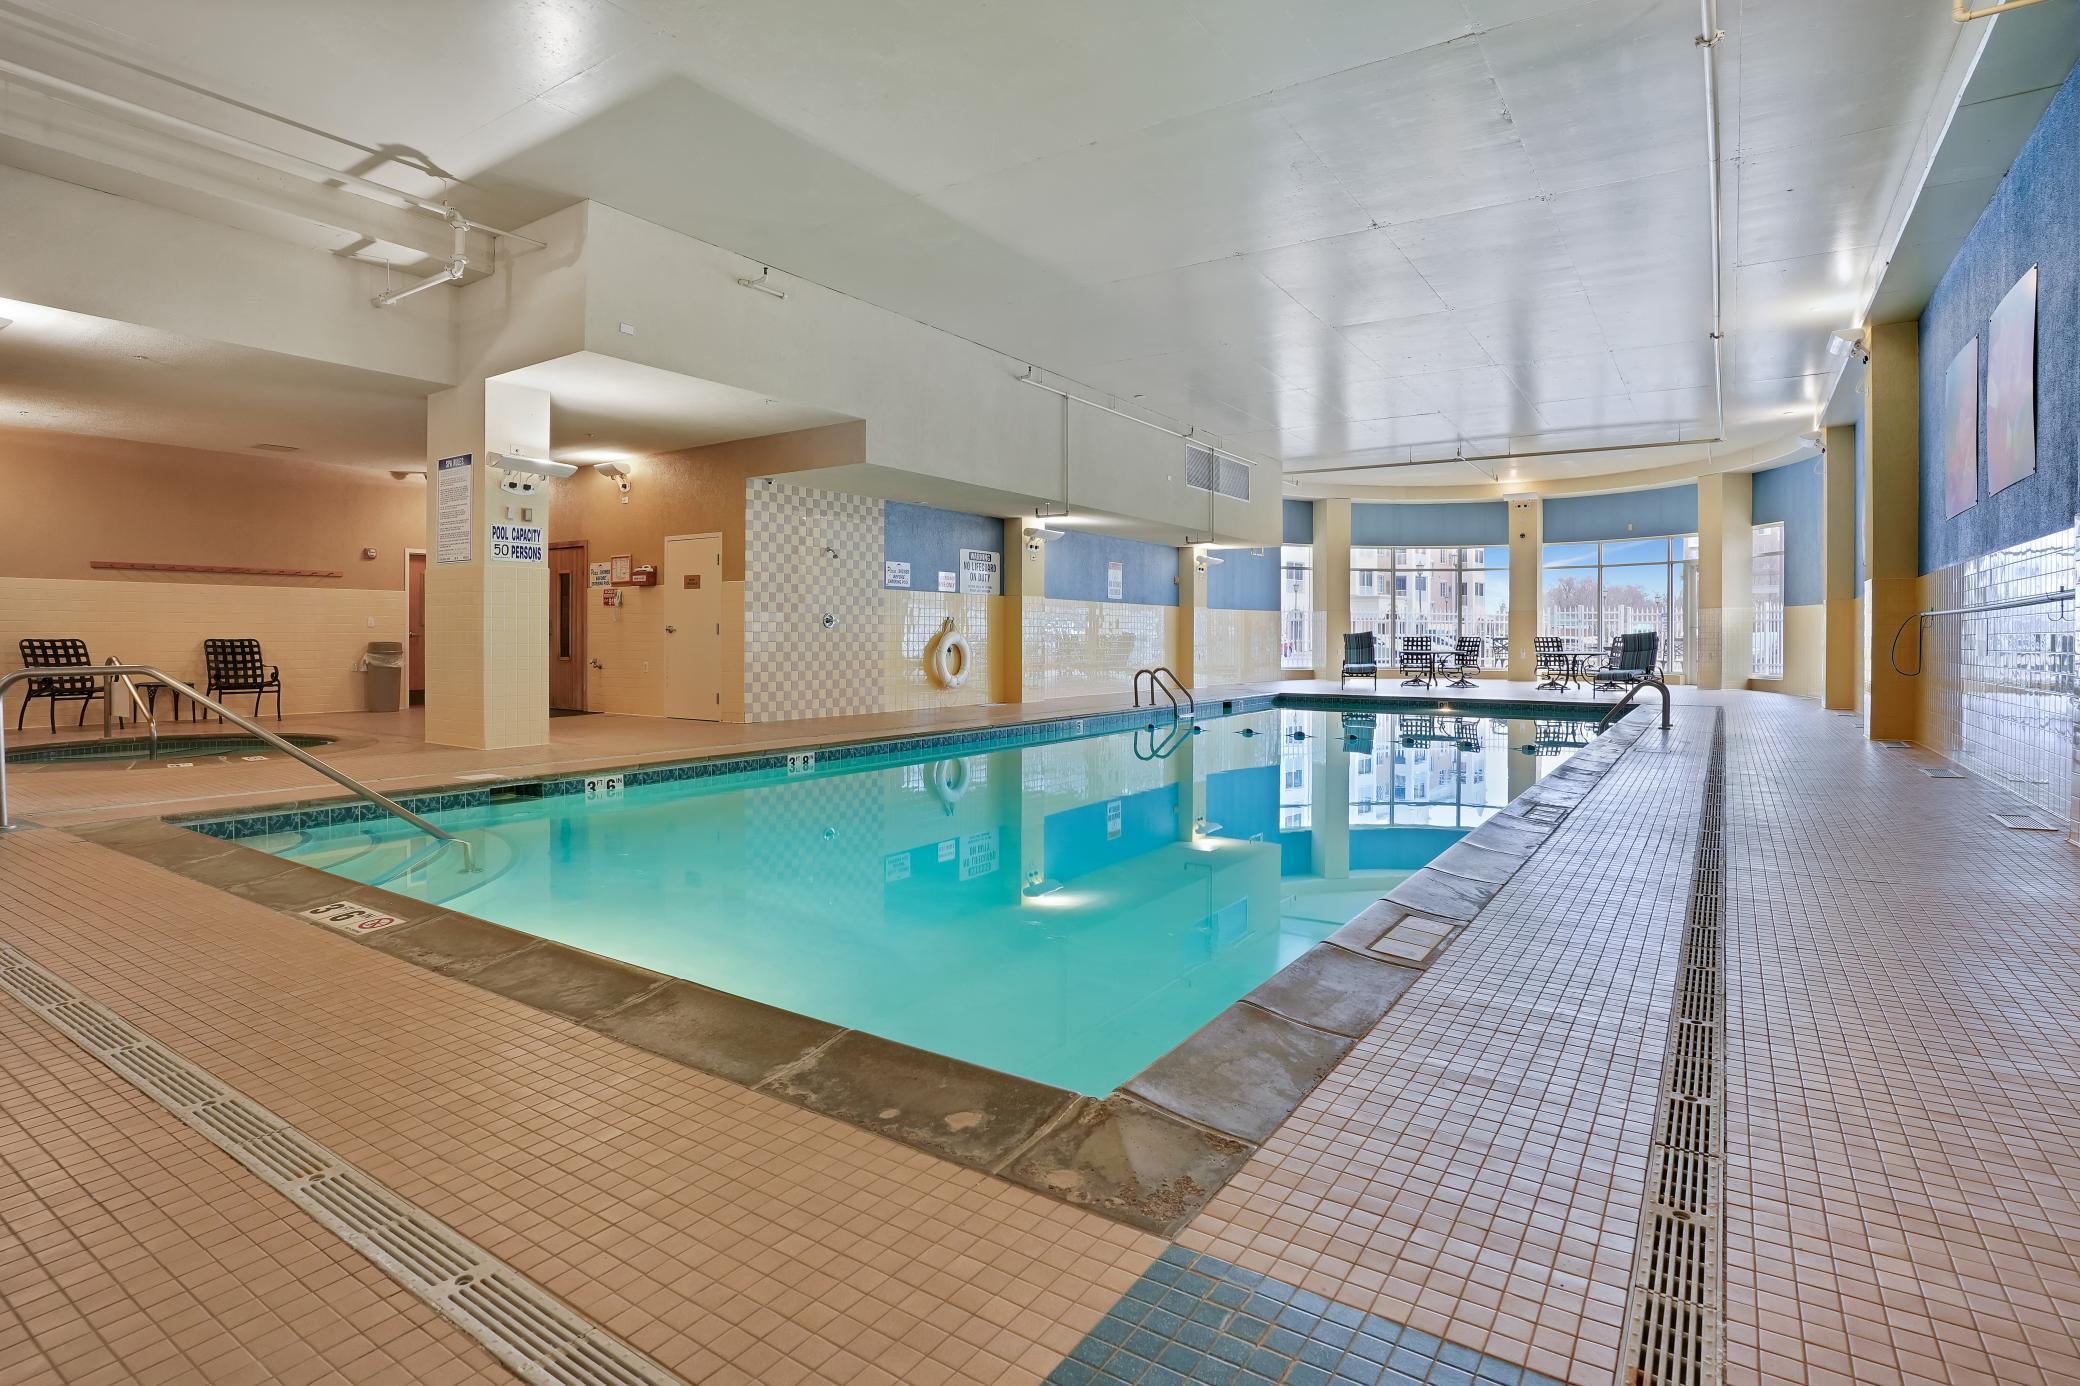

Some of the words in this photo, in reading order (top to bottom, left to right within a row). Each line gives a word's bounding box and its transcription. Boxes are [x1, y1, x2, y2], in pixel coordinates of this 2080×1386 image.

[492, 525, 508, 540] POOL
[511, 527, 541, 543] CAPACITY
[494, 543, 509, 556] 50
[511, 544, 541, 561] PERSONS
[963, 560, 970, 570] NO
[972, 561, 996, 573] LIFEGUARD
[970, 572, 976, 582] ON
[978, 573, 990, 583] DUTY
[787, 756, 796, 767] 3
[587, 780, 597, 792] 3
[606, 778, 616, 790] 6
